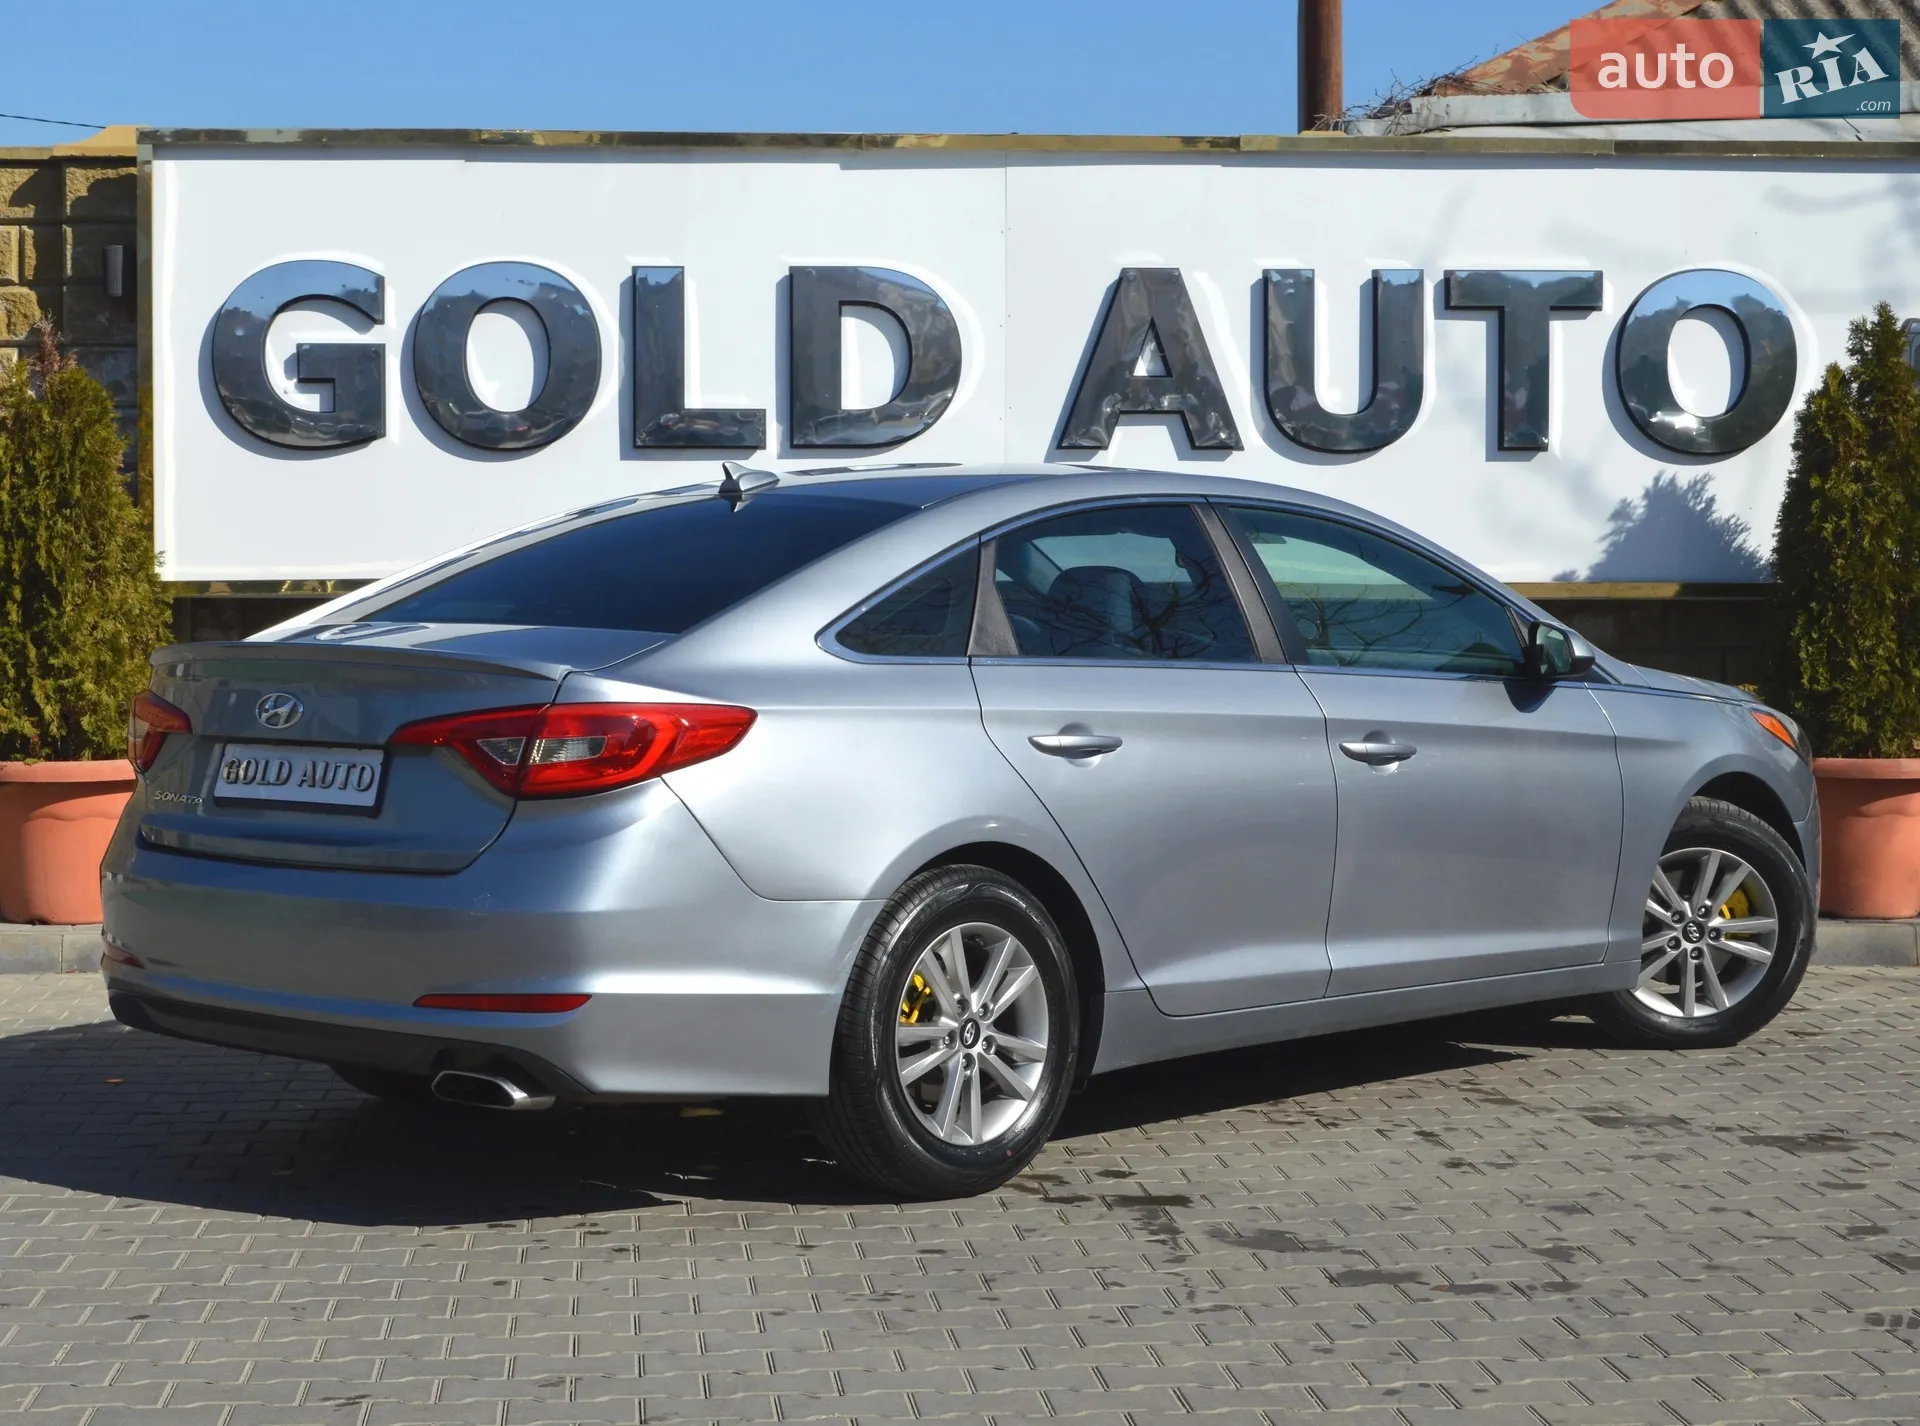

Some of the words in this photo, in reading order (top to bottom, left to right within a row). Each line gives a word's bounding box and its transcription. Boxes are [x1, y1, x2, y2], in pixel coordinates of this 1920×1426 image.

[212, 259, 962, 452] GOLD
[1056, 267, 1798, 455] AUTO
[222, 757, 292, 786] GOLD
[297, 760, 375, 792] AUTO
[153, 790, 204, 804] SONATA
